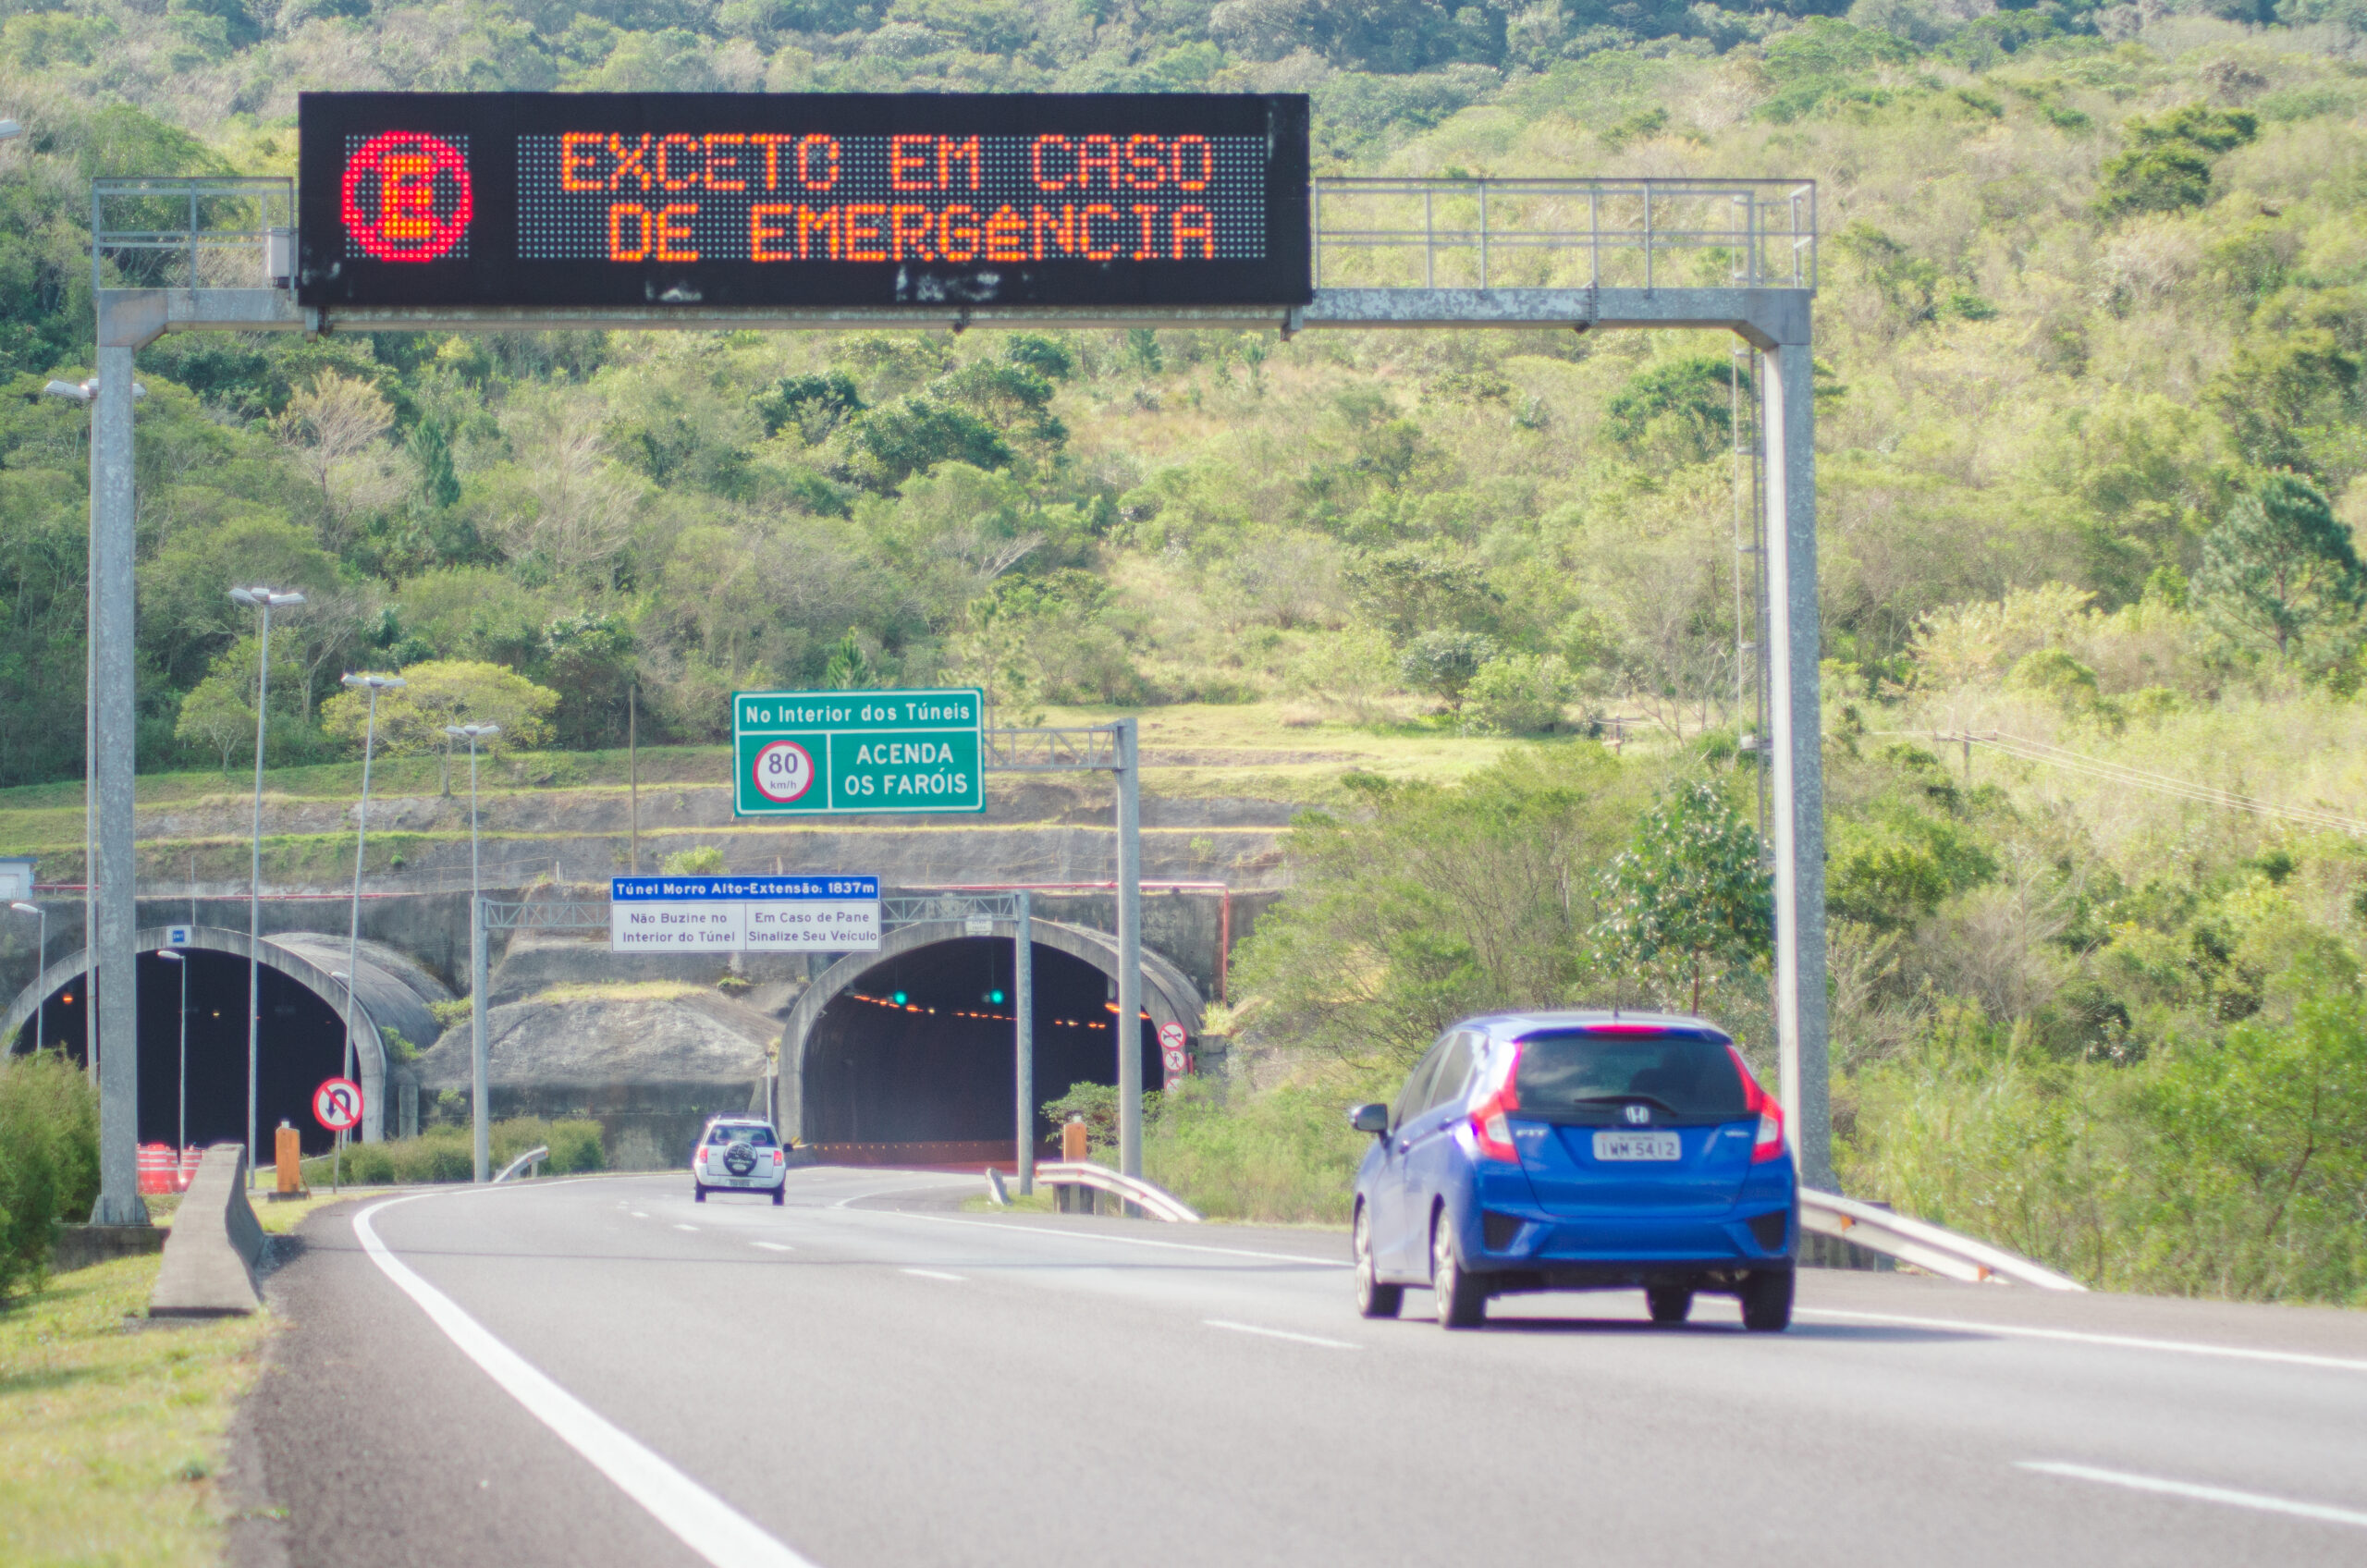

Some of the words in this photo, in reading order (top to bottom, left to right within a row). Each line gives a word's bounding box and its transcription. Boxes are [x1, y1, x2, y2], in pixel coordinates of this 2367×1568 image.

[561, 132, 840, 190] EXCETO
[890, 134, 980, 190] EM
[1031, 133, 1213, 190] CASO
[609, 202, 700, 263] DE
[746, 705, 771, 723] No
[779, 704, 852, 723] Interior
[861, 704, 897, 721] dos
[905, 703, 970, 721] Túneis
[856, 742, 954, 765] ACENDA
[768, 753, 798, 774] 80
[770, 780, 796, 790] km/h
[844, 775, 875, 795] OS
[883, 767, 968, 794] FARÓIS
[617, 883, 658, 895] Túnel
[663, 883, 706, 895] Morro
[828, 882, 875, 894] 1837m
[631, 913, 656, 924] Não
[661, 913, 706, 924] Buzine
[711, 914, 727, 923] no
[754, 913, 775, 923] Em
[780, 913, 812, 923] Caso
[817, 913, 832, 922] de
[837, 912, 869, 922] Pane
[623, 932, 673, 942] Interior
[679, 932, 693, 942] do
[699, 931, 735, 942] Túnel
[749, 931, 798, 941] Sinalize
[803, 931, 826, 941] Seu
[831, 930, 877, 941] Veículo
